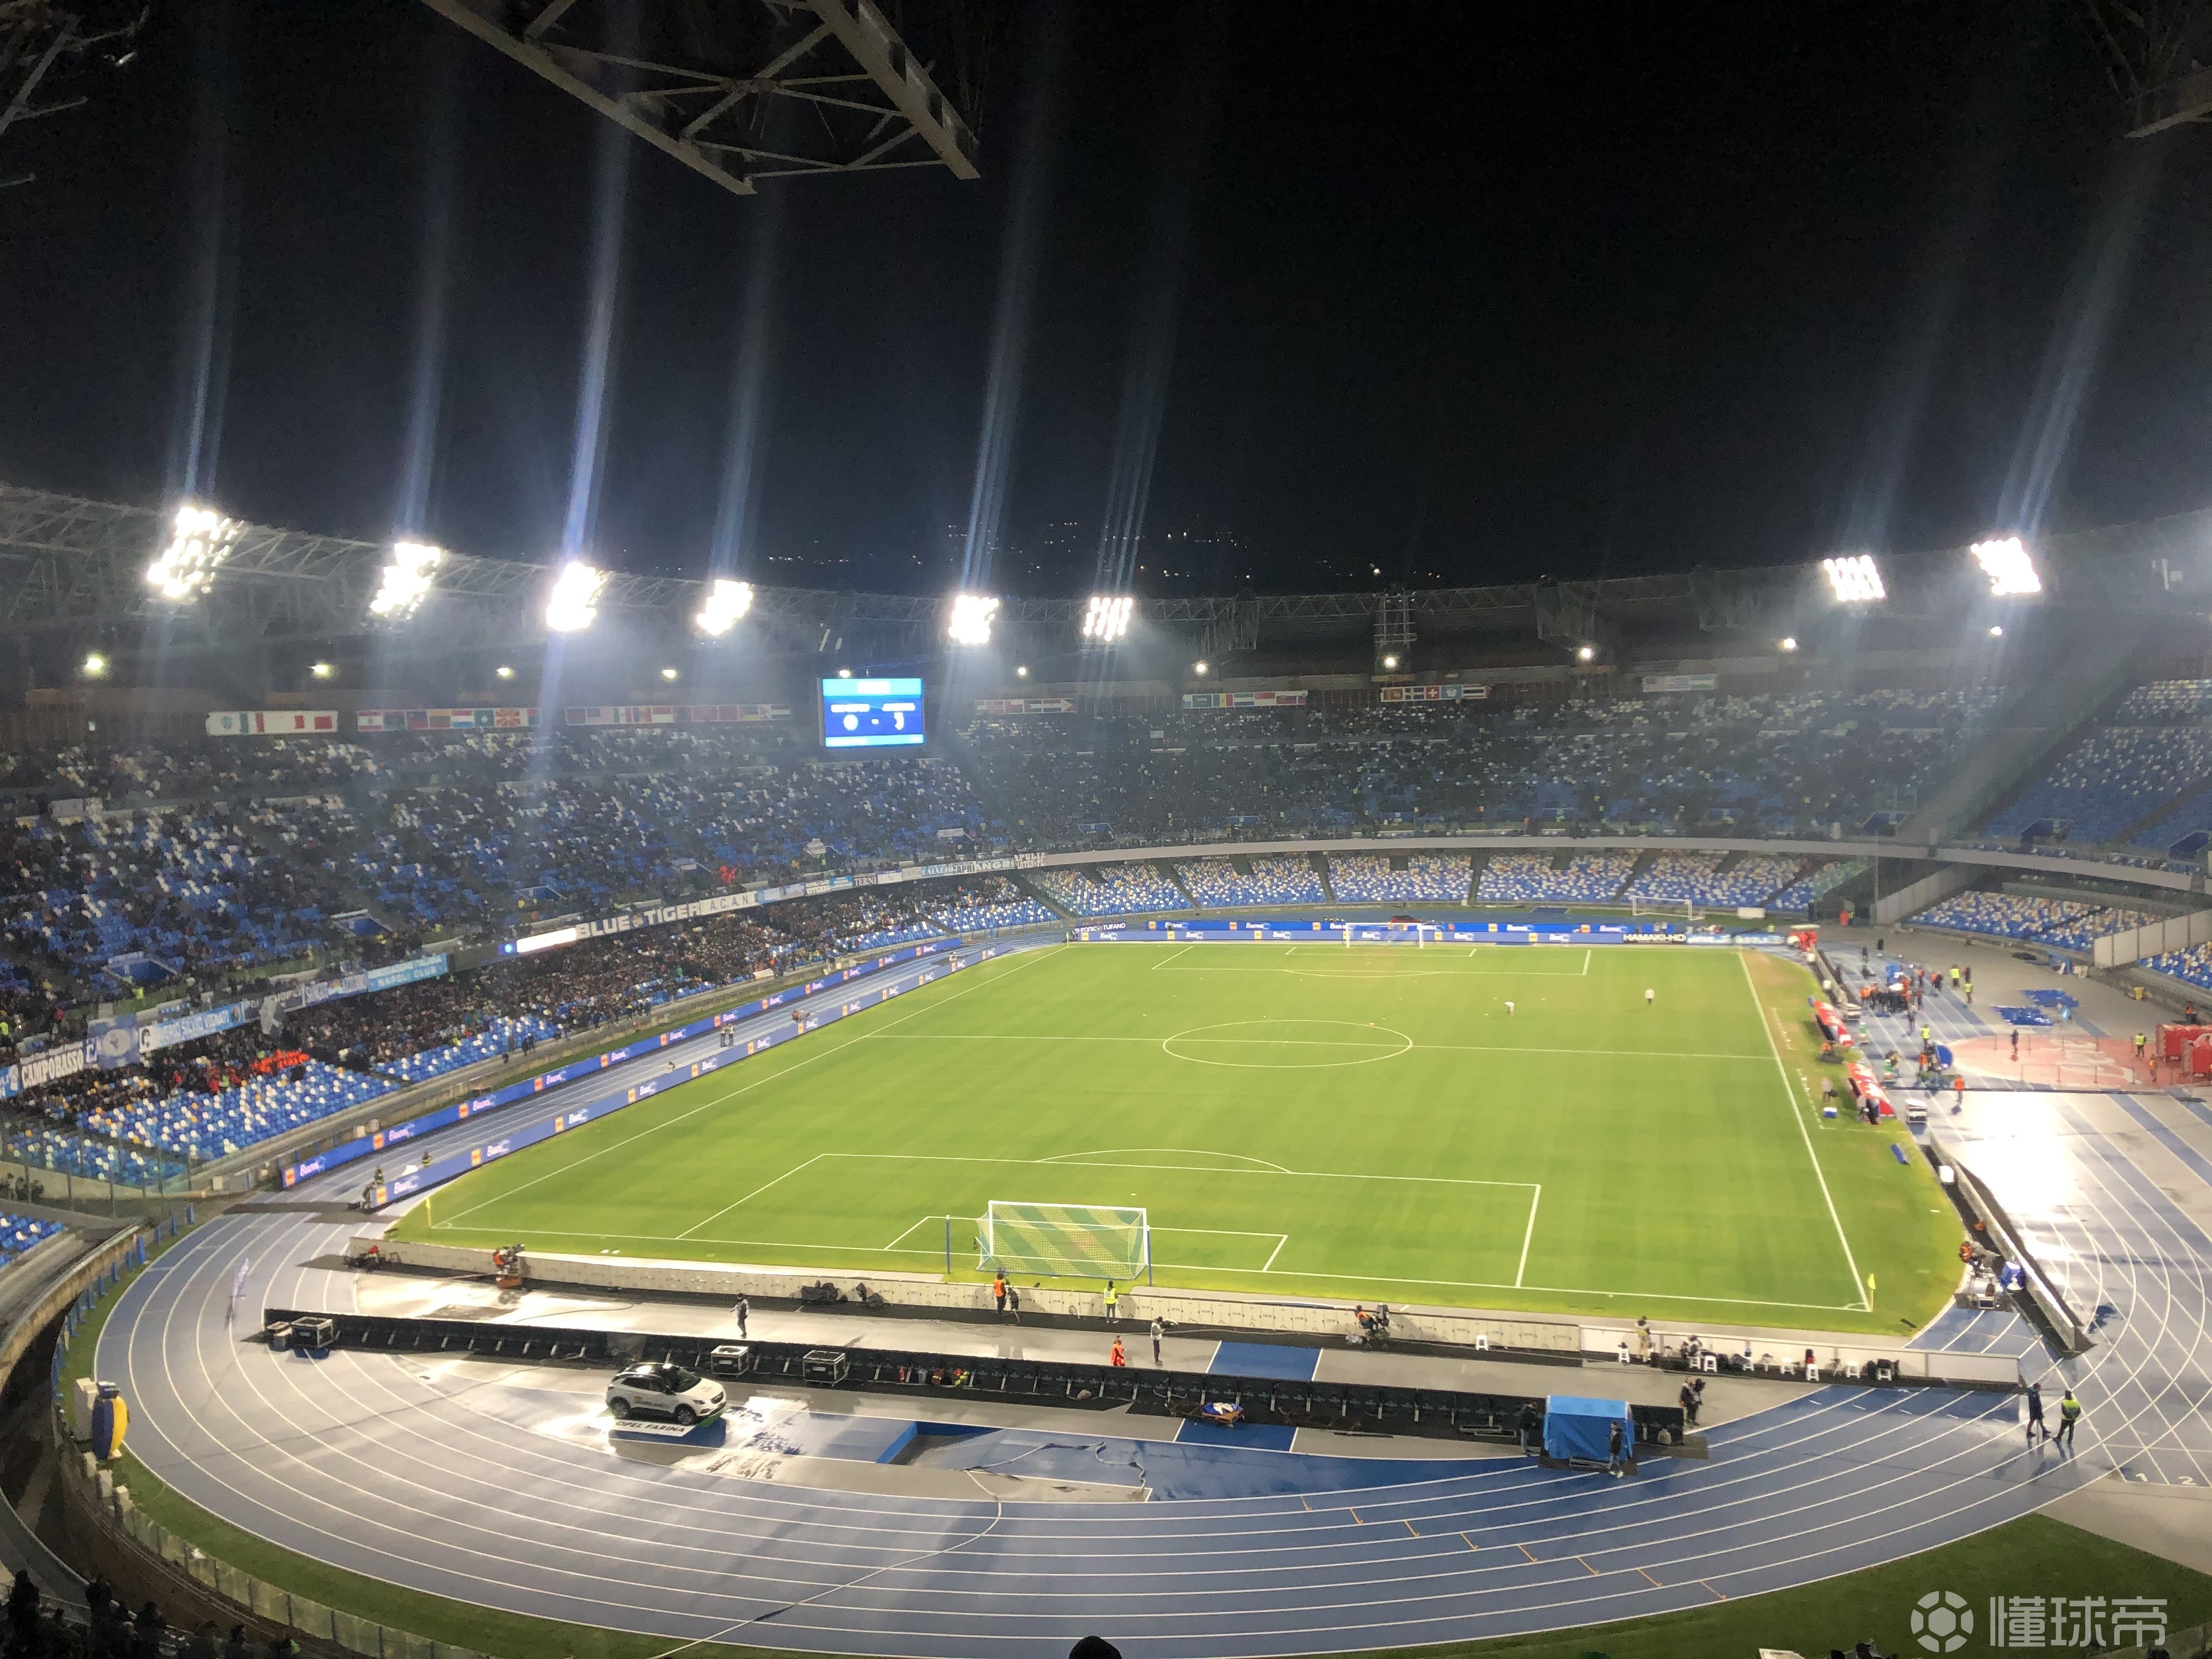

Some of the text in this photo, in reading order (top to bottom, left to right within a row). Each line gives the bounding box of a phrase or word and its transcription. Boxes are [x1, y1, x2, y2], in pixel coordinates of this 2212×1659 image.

[854, 876, 877, 887] TERNI
[576, 902, 702, 939] BLUE TIGER
[21, 1049, 84, 1088] CAMPOBASSO
[616, 1421, 685, 1433] OPEL FARINA
[2135, 1472, 2148, 1482] 1
[2178, 1476, 2197, 1486] 2
